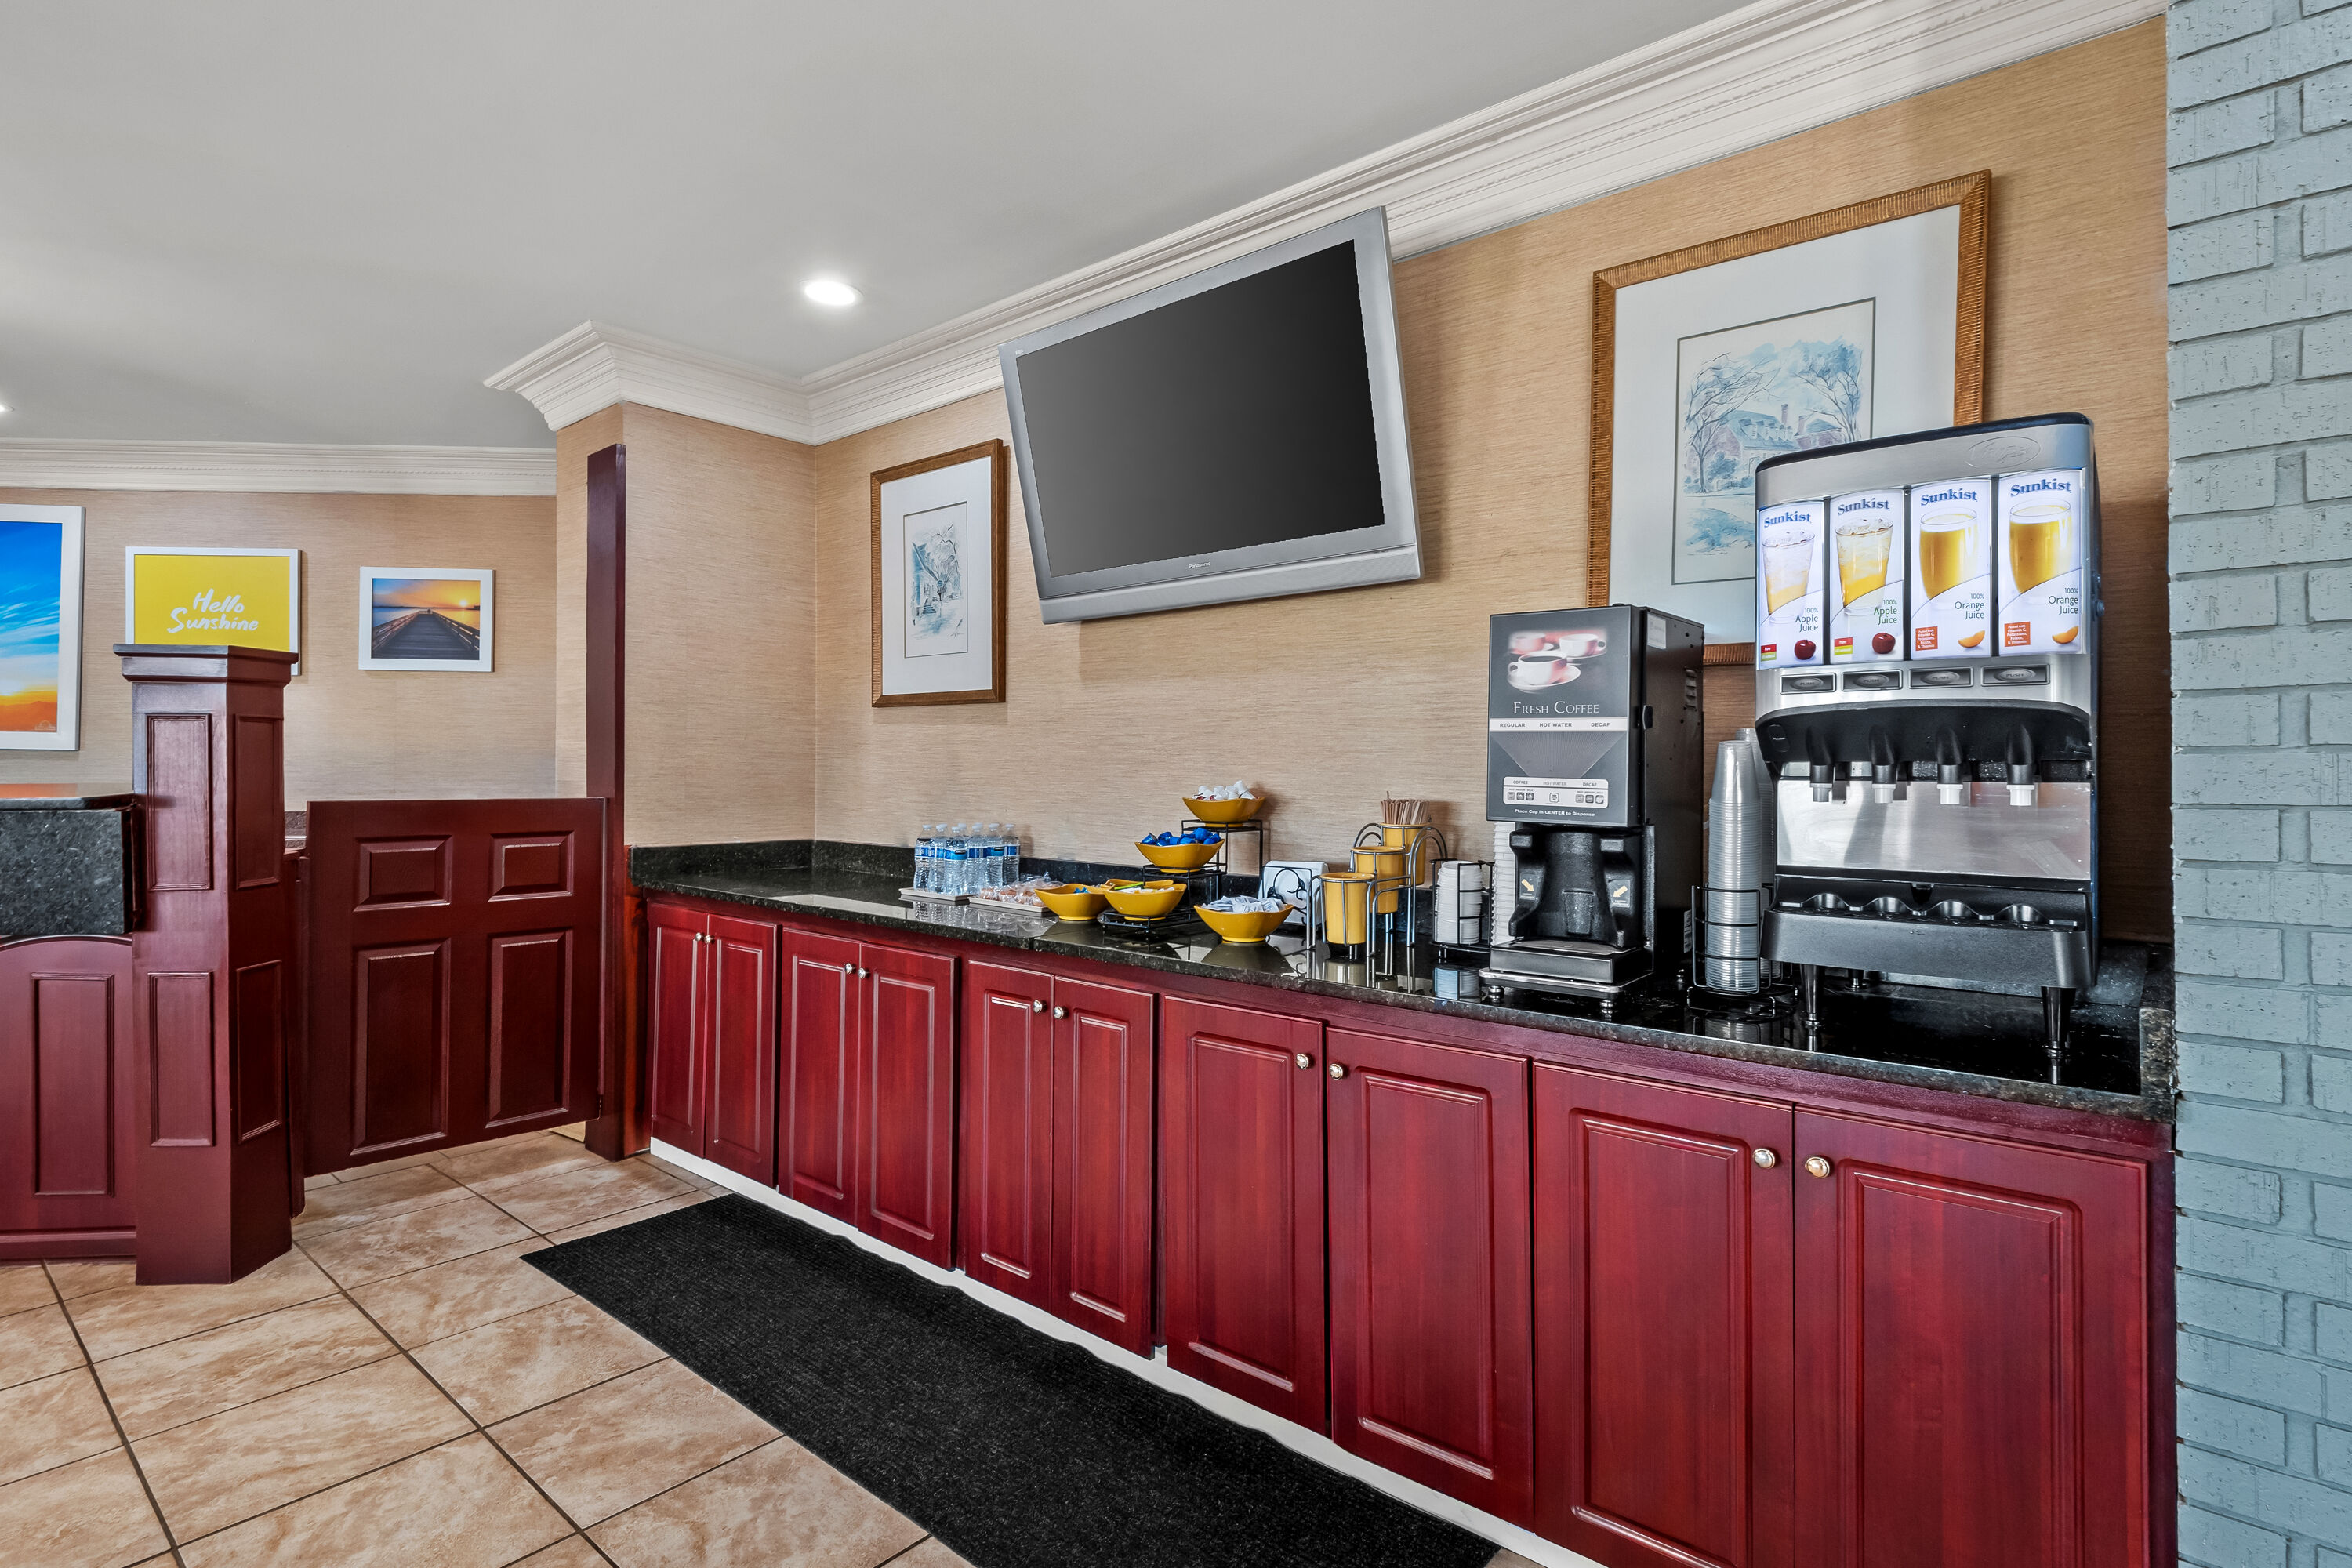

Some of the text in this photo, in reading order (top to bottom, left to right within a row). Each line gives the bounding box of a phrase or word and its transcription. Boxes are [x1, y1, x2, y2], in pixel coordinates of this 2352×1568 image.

[2010, 478, 2072, 497] Sunkist
[1921, 488, 1978, 506] Sunkist
[1838, 498, 1890, 516] Sunkist
[1764, 510, 1812, 528] Sunkist
[193, 588, 245, 613] Hello
[1955, 601, 1985, 612] Orange
[2048, 595, 2078, 607] Orange
[1873, 606, 1897, 619] Apple
[1965, 611, 1985, 620] Juice
[2059, 606, 2078, 615] Juice
[166, 607, 259, 633] Sunshine
[1795, 615, 1819, 626] Apple
[1878, 615, 1897, 626] Juice
[1799, 622, 1819, 632] Juice
[1513, 701, 1599, 714] FRESH COFFEE
